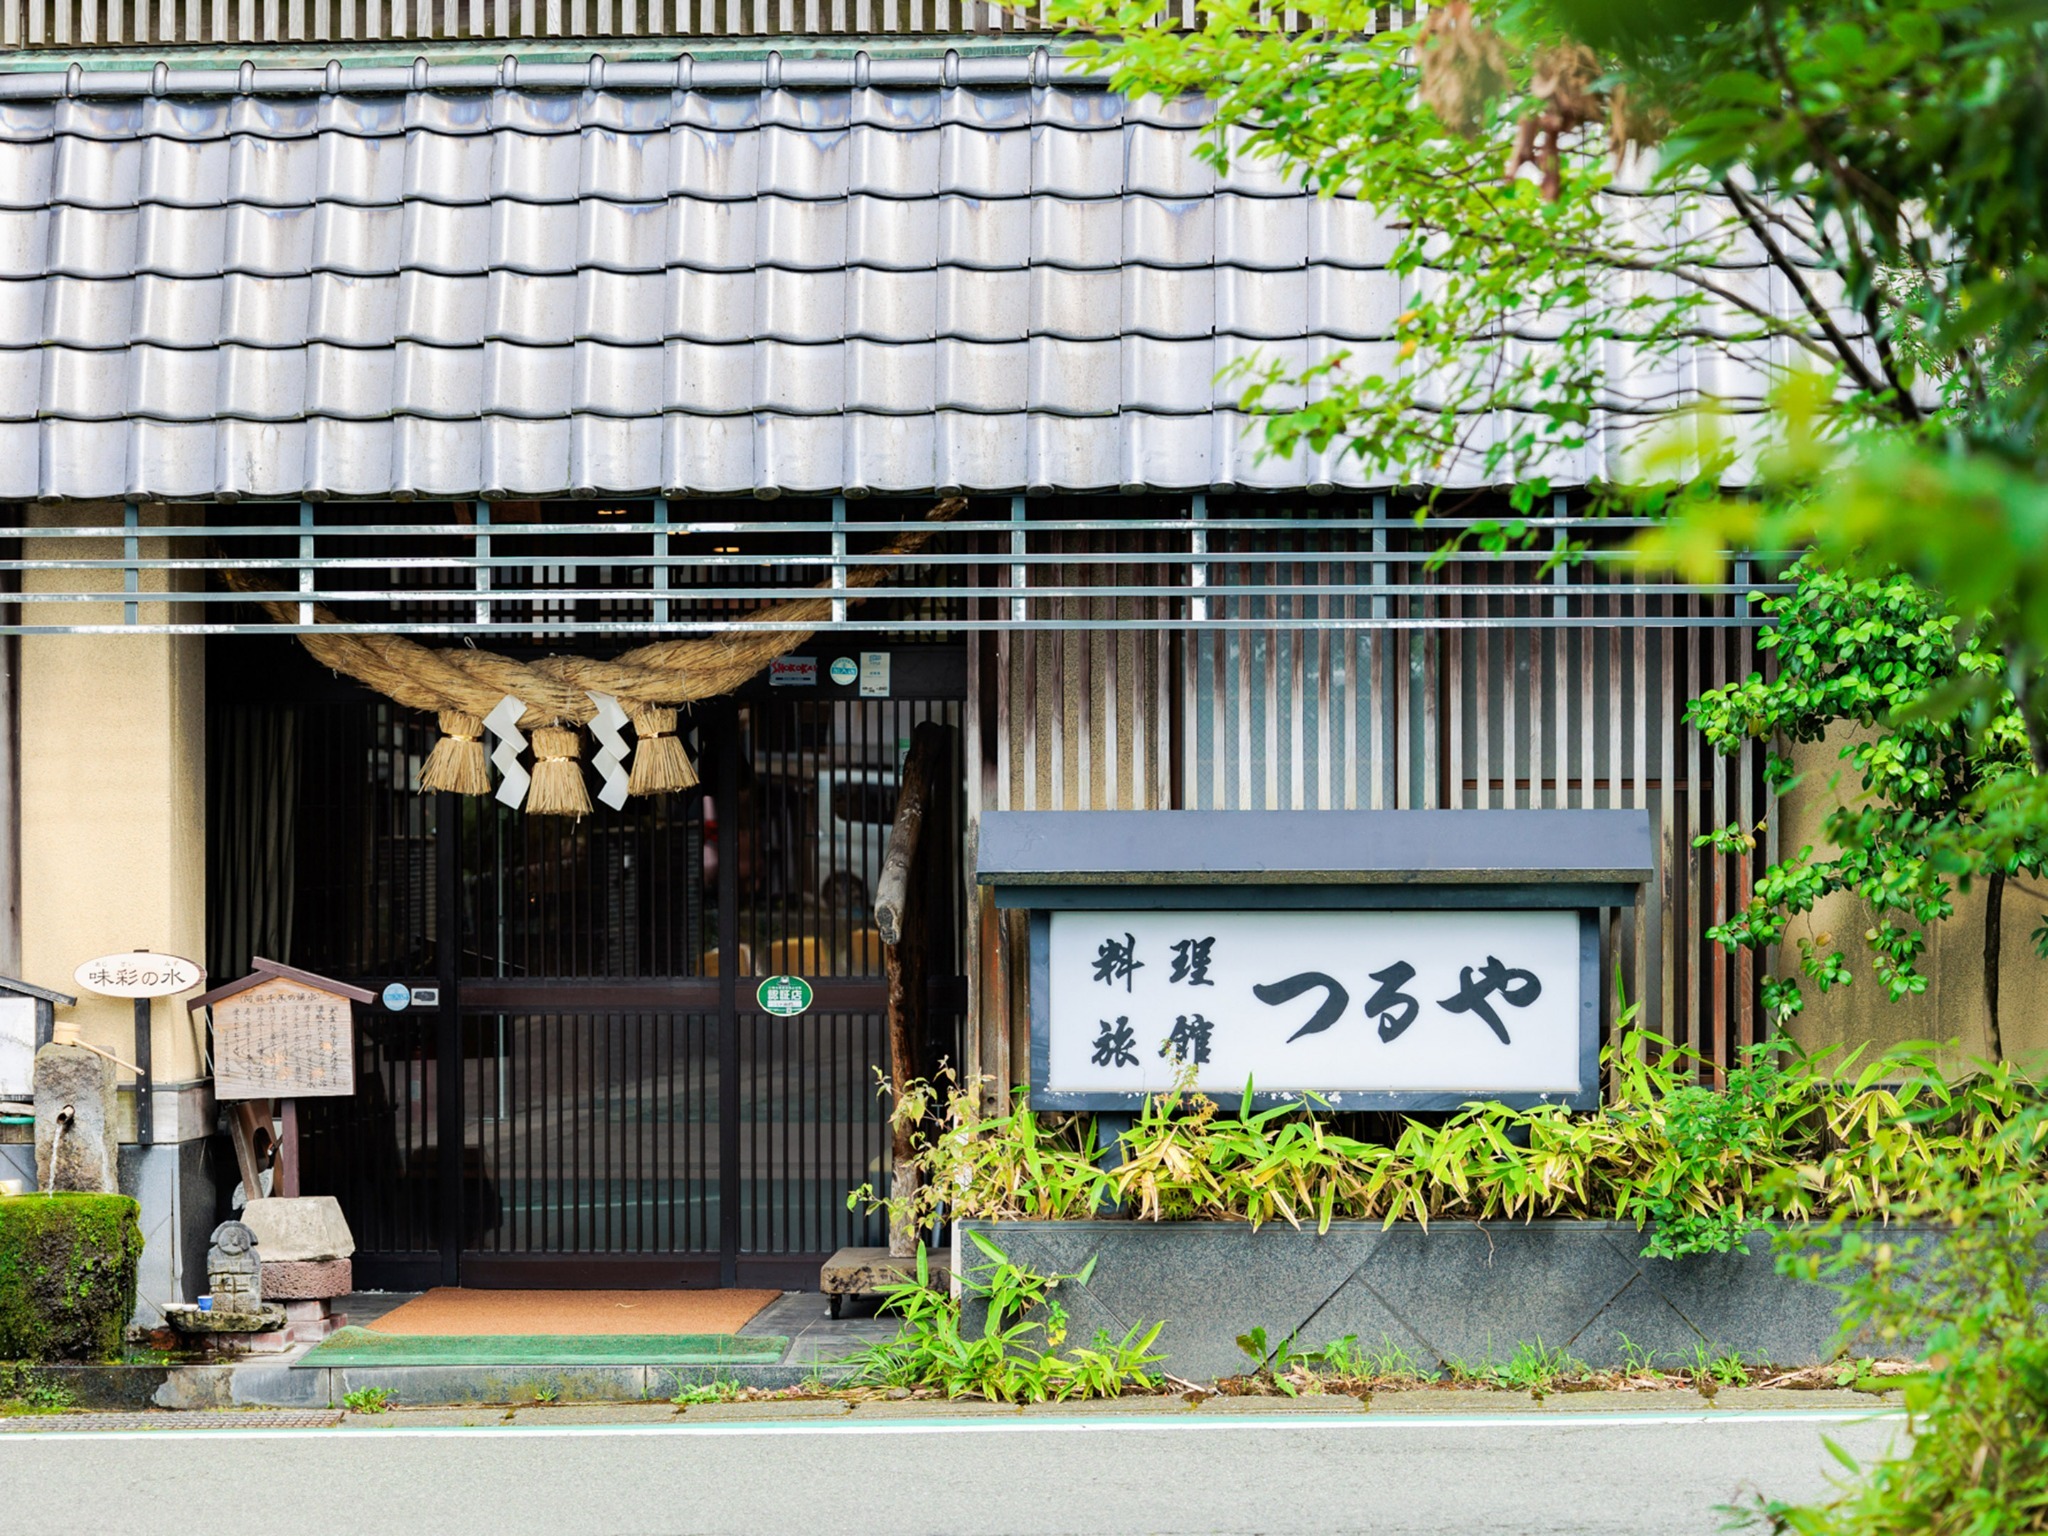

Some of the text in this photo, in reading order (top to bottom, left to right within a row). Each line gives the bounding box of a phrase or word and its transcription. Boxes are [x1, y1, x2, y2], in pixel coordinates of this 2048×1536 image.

[89, 968, 186, 987] 味彩の水
[1091, 932, 1216, 993] 料理
[1253, 955, 1541, 1045] つるや
[1091, 1013, 1215, 1071] 旅館
